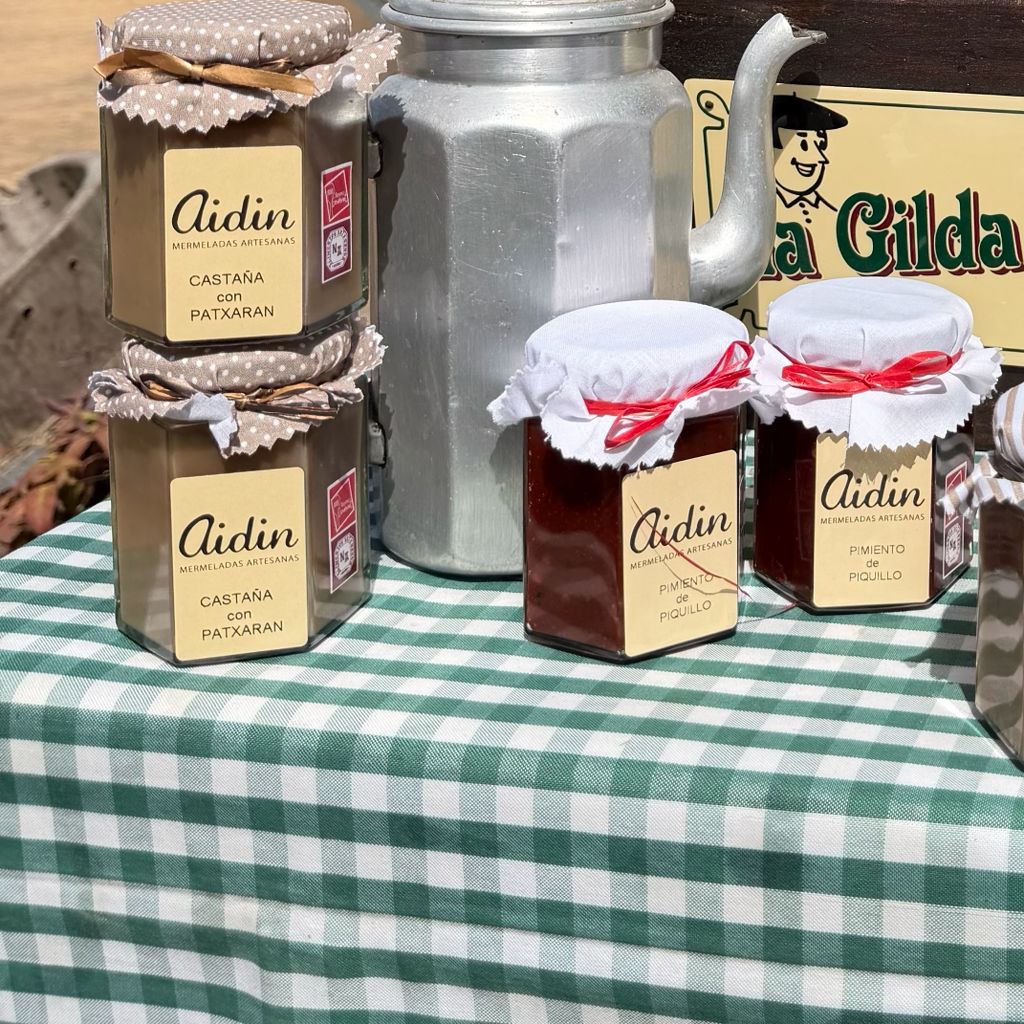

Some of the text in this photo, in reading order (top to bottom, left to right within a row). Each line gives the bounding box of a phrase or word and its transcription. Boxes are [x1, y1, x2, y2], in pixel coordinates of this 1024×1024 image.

[171, 189, 296, 235] Aidin
[172, 237, 296, 251] MERMELADAS ARTESANAS
[189, 270, 265, 287] CASTAÑA
[216, 292, 242, 303] con
[190, 306, 275, 322] PATXARAN
[821, 469, 926, 511] Aidin
[820, 513, 926, 525] MERMELADAS ARTESANAS
[178, 513, 299, 558] Aidin
[629, 504, 733, 555] Aidin
[630, 538, 733, 570] MERMELADAS ARTESANAS
[849, 544, 906, 556] PIMIENTO
[179, 554, 300, 574] MERMELADAS ARTESANAS
[866, 558, 880, 568] de
[659, 573, 715, 595] PIMIENTO
[849, 570, 903, 582] PIQUILLO
[200, 588, 273, 608] CASTAÑA
[676, 593, 690, 604] de
[227, 610, 252, 622] con
[659, 599, 712, 623] PIQUILLO
[202, 620, 284, 641] PATXARAN
